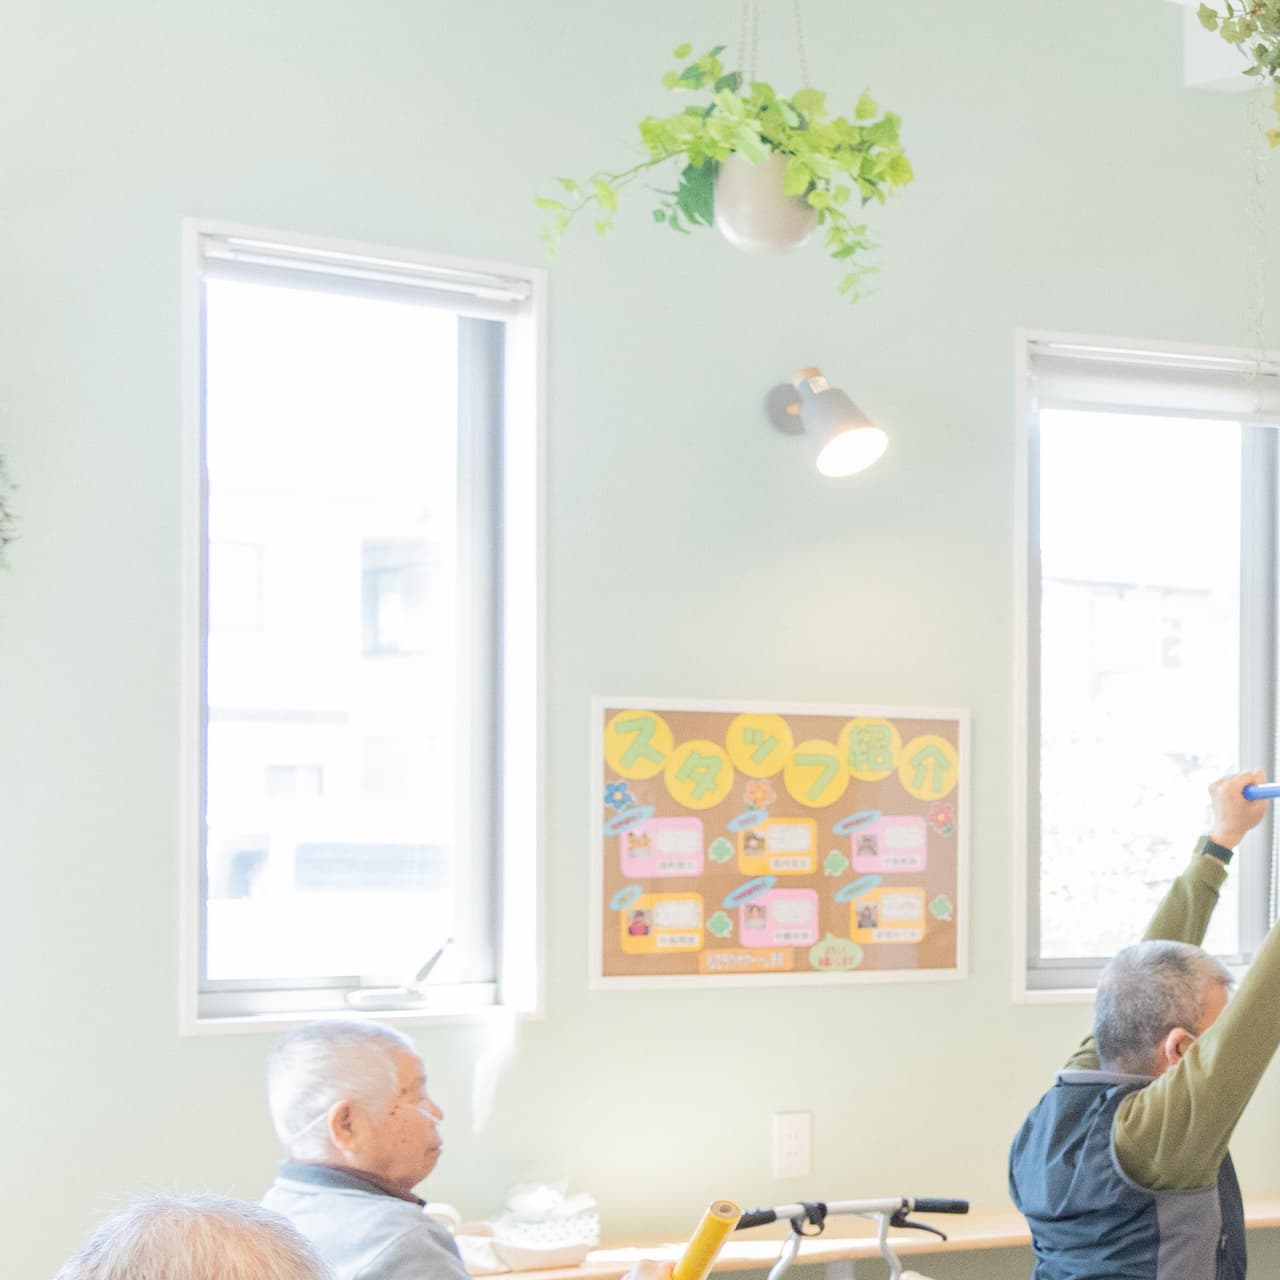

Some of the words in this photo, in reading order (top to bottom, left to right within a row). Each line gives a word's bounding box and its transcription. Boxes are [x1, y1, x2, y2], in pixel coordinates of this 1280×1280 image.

[615, 717, 951, 800] スタッフ紹介
